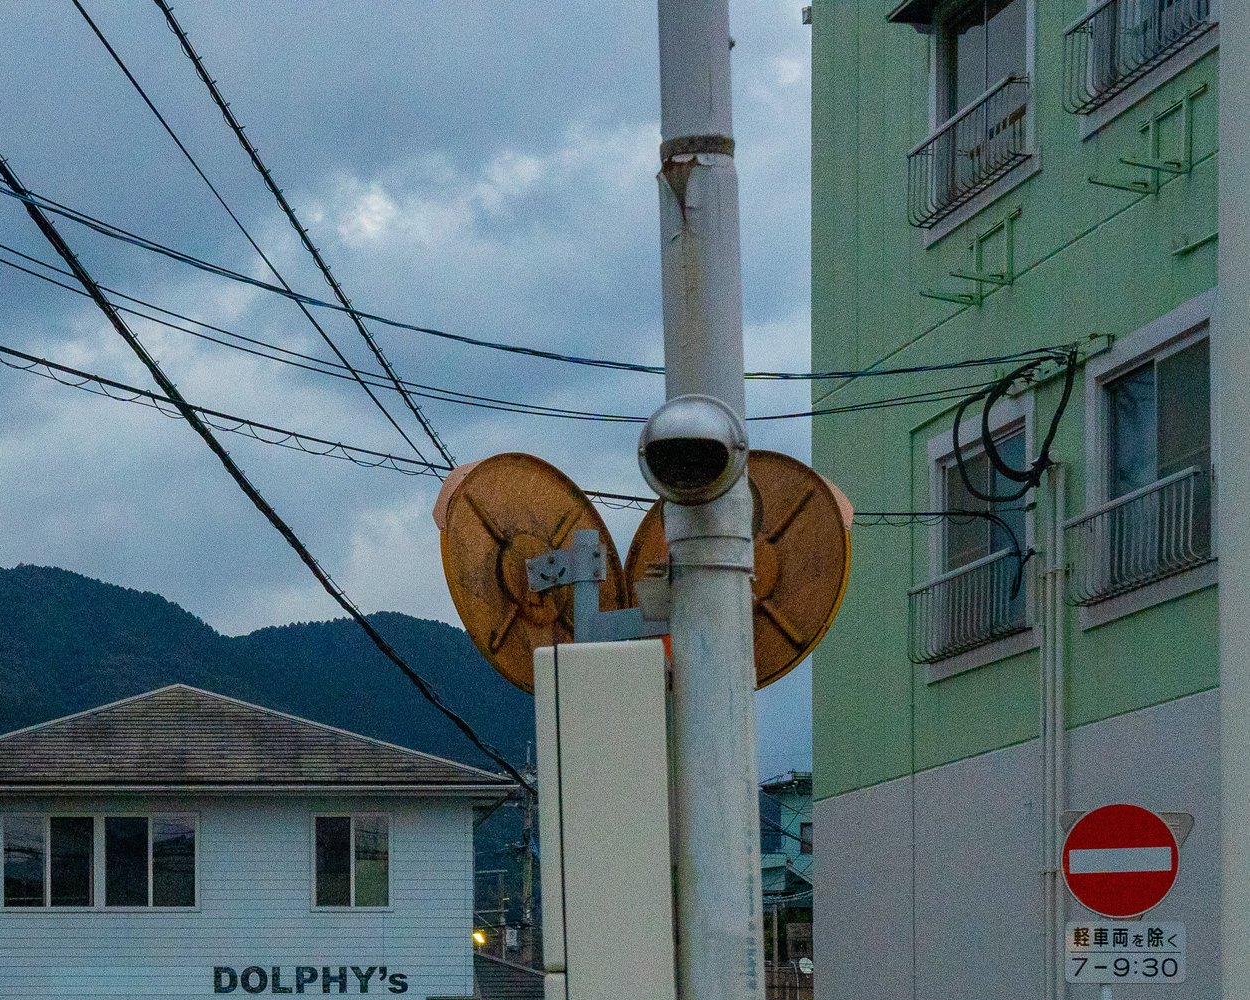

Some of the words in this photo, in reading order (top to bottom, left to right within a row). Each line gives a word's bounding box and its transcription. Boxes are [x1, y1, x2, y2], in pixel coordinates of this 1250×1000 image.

[1074, 927, 1178, 947] 軽車両を除く
